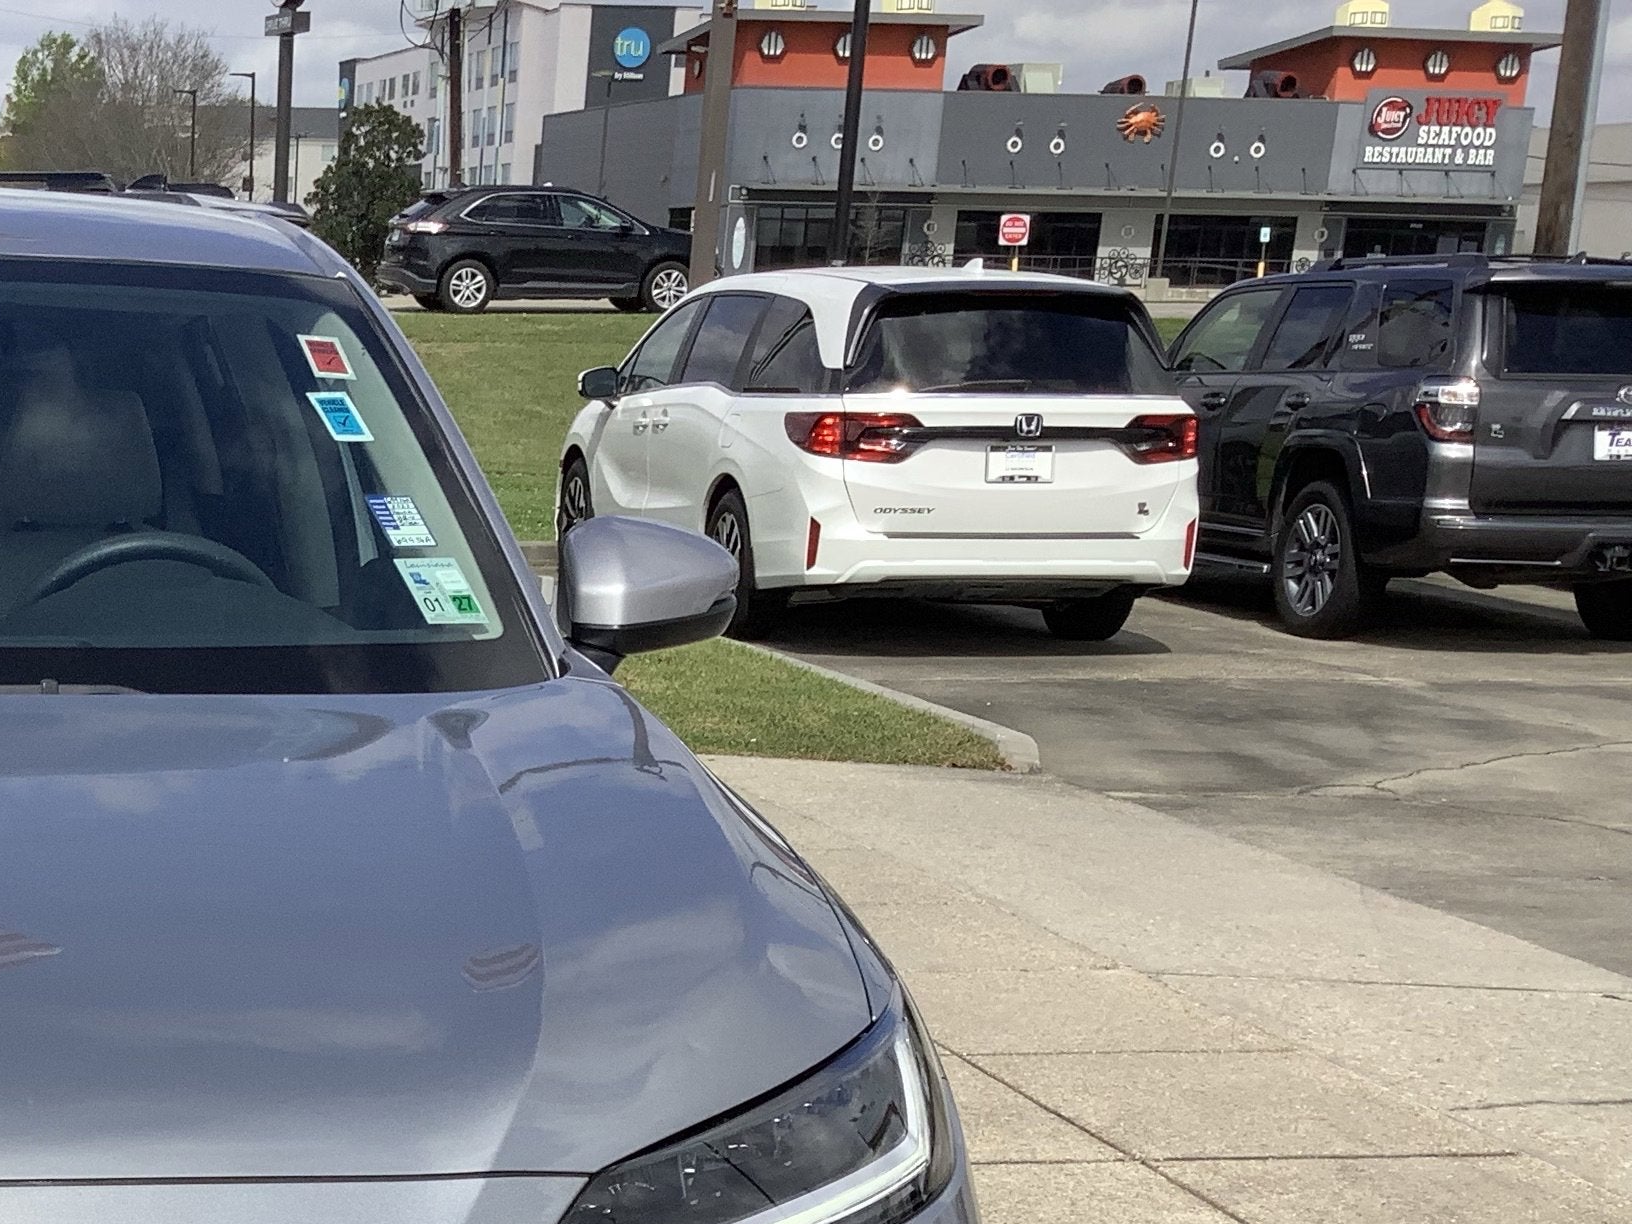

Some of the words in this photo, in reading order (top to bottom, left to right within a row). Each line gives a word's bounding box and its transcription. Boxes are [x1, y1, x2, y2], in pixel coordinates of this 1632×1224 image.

[615, 36, 643, 57] tru
[1376, 106, 1406, 123] JUICY
[1416, 96, 1502, 127] JUICY
[1417, 125, 1496, 146] SEAFOOD
[1364, 146, 1452, 164] RESTAURANT
[1455, 148, 1464, 164] &
[1467, 148, 1495, 165] BAR
[1608, 432, 1632, 447] TEA
[404, 561, 454, 569] Louisiana
[423, 597, 445, 612] 01
[452, 596, 473, 611] 27
